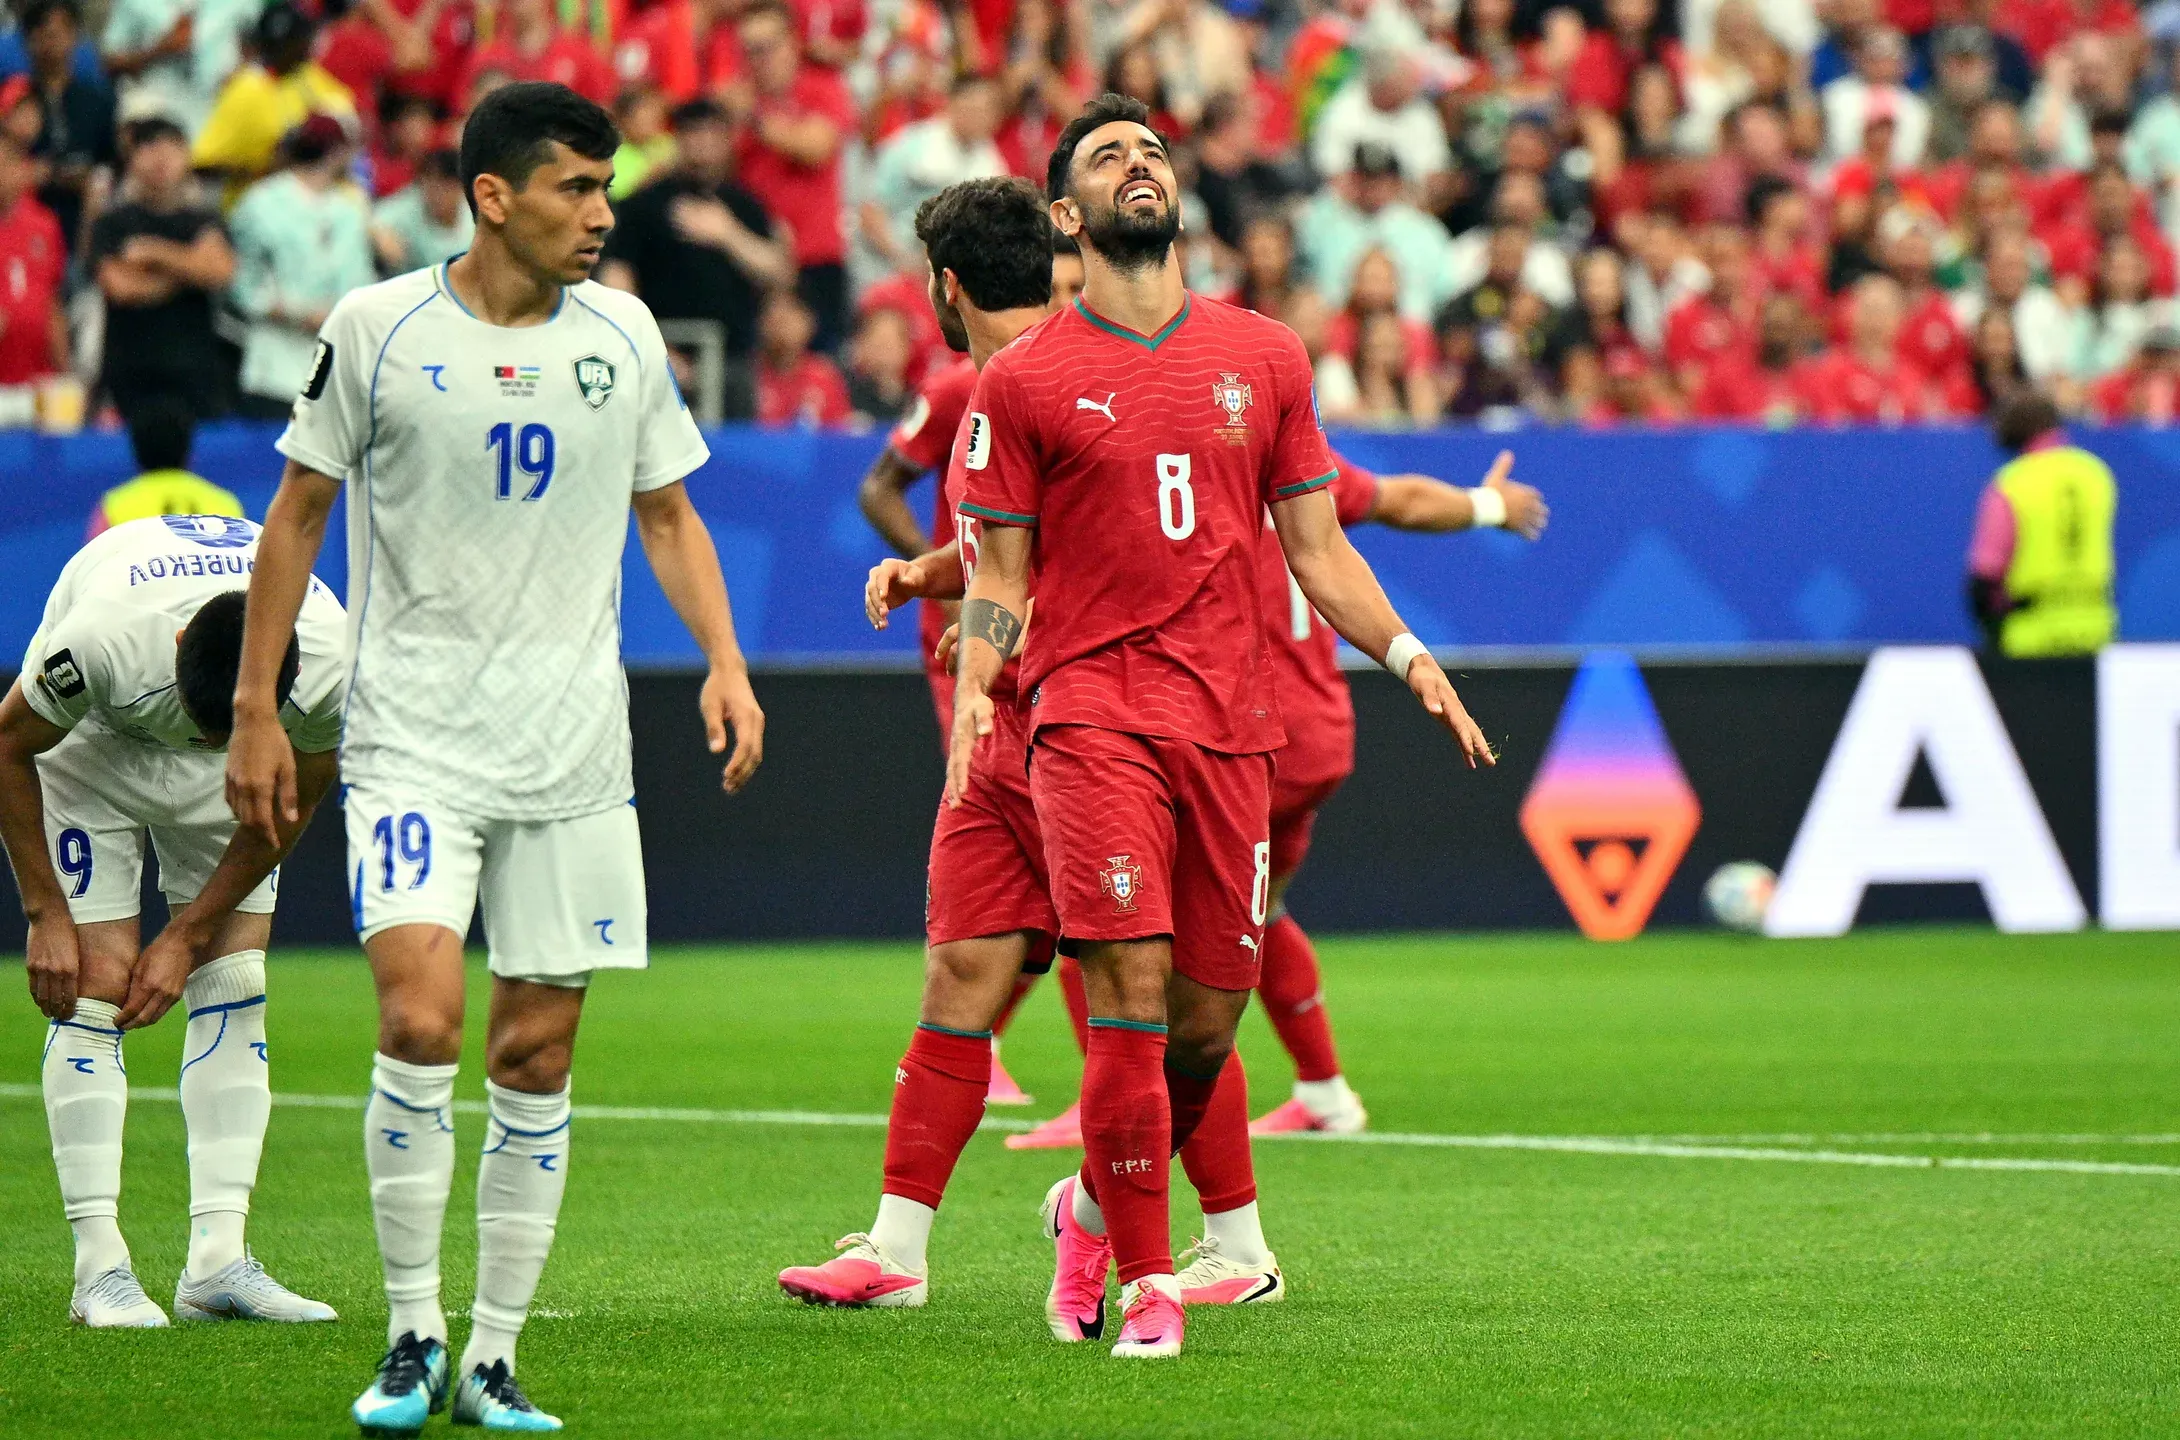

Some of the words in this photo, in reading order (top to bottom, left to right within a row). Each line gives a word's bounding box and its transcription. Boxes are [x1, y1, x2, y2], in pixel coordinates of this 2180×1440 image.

[578, 363, 613, 386] UFA
[484, 421, 556, 502] 19
[1156, 452, 1196, 541] 8
[55, 828, 94, 899] 9
[372, 811, 432, 894] 19
[1251, 840, 1270, 927] 8
